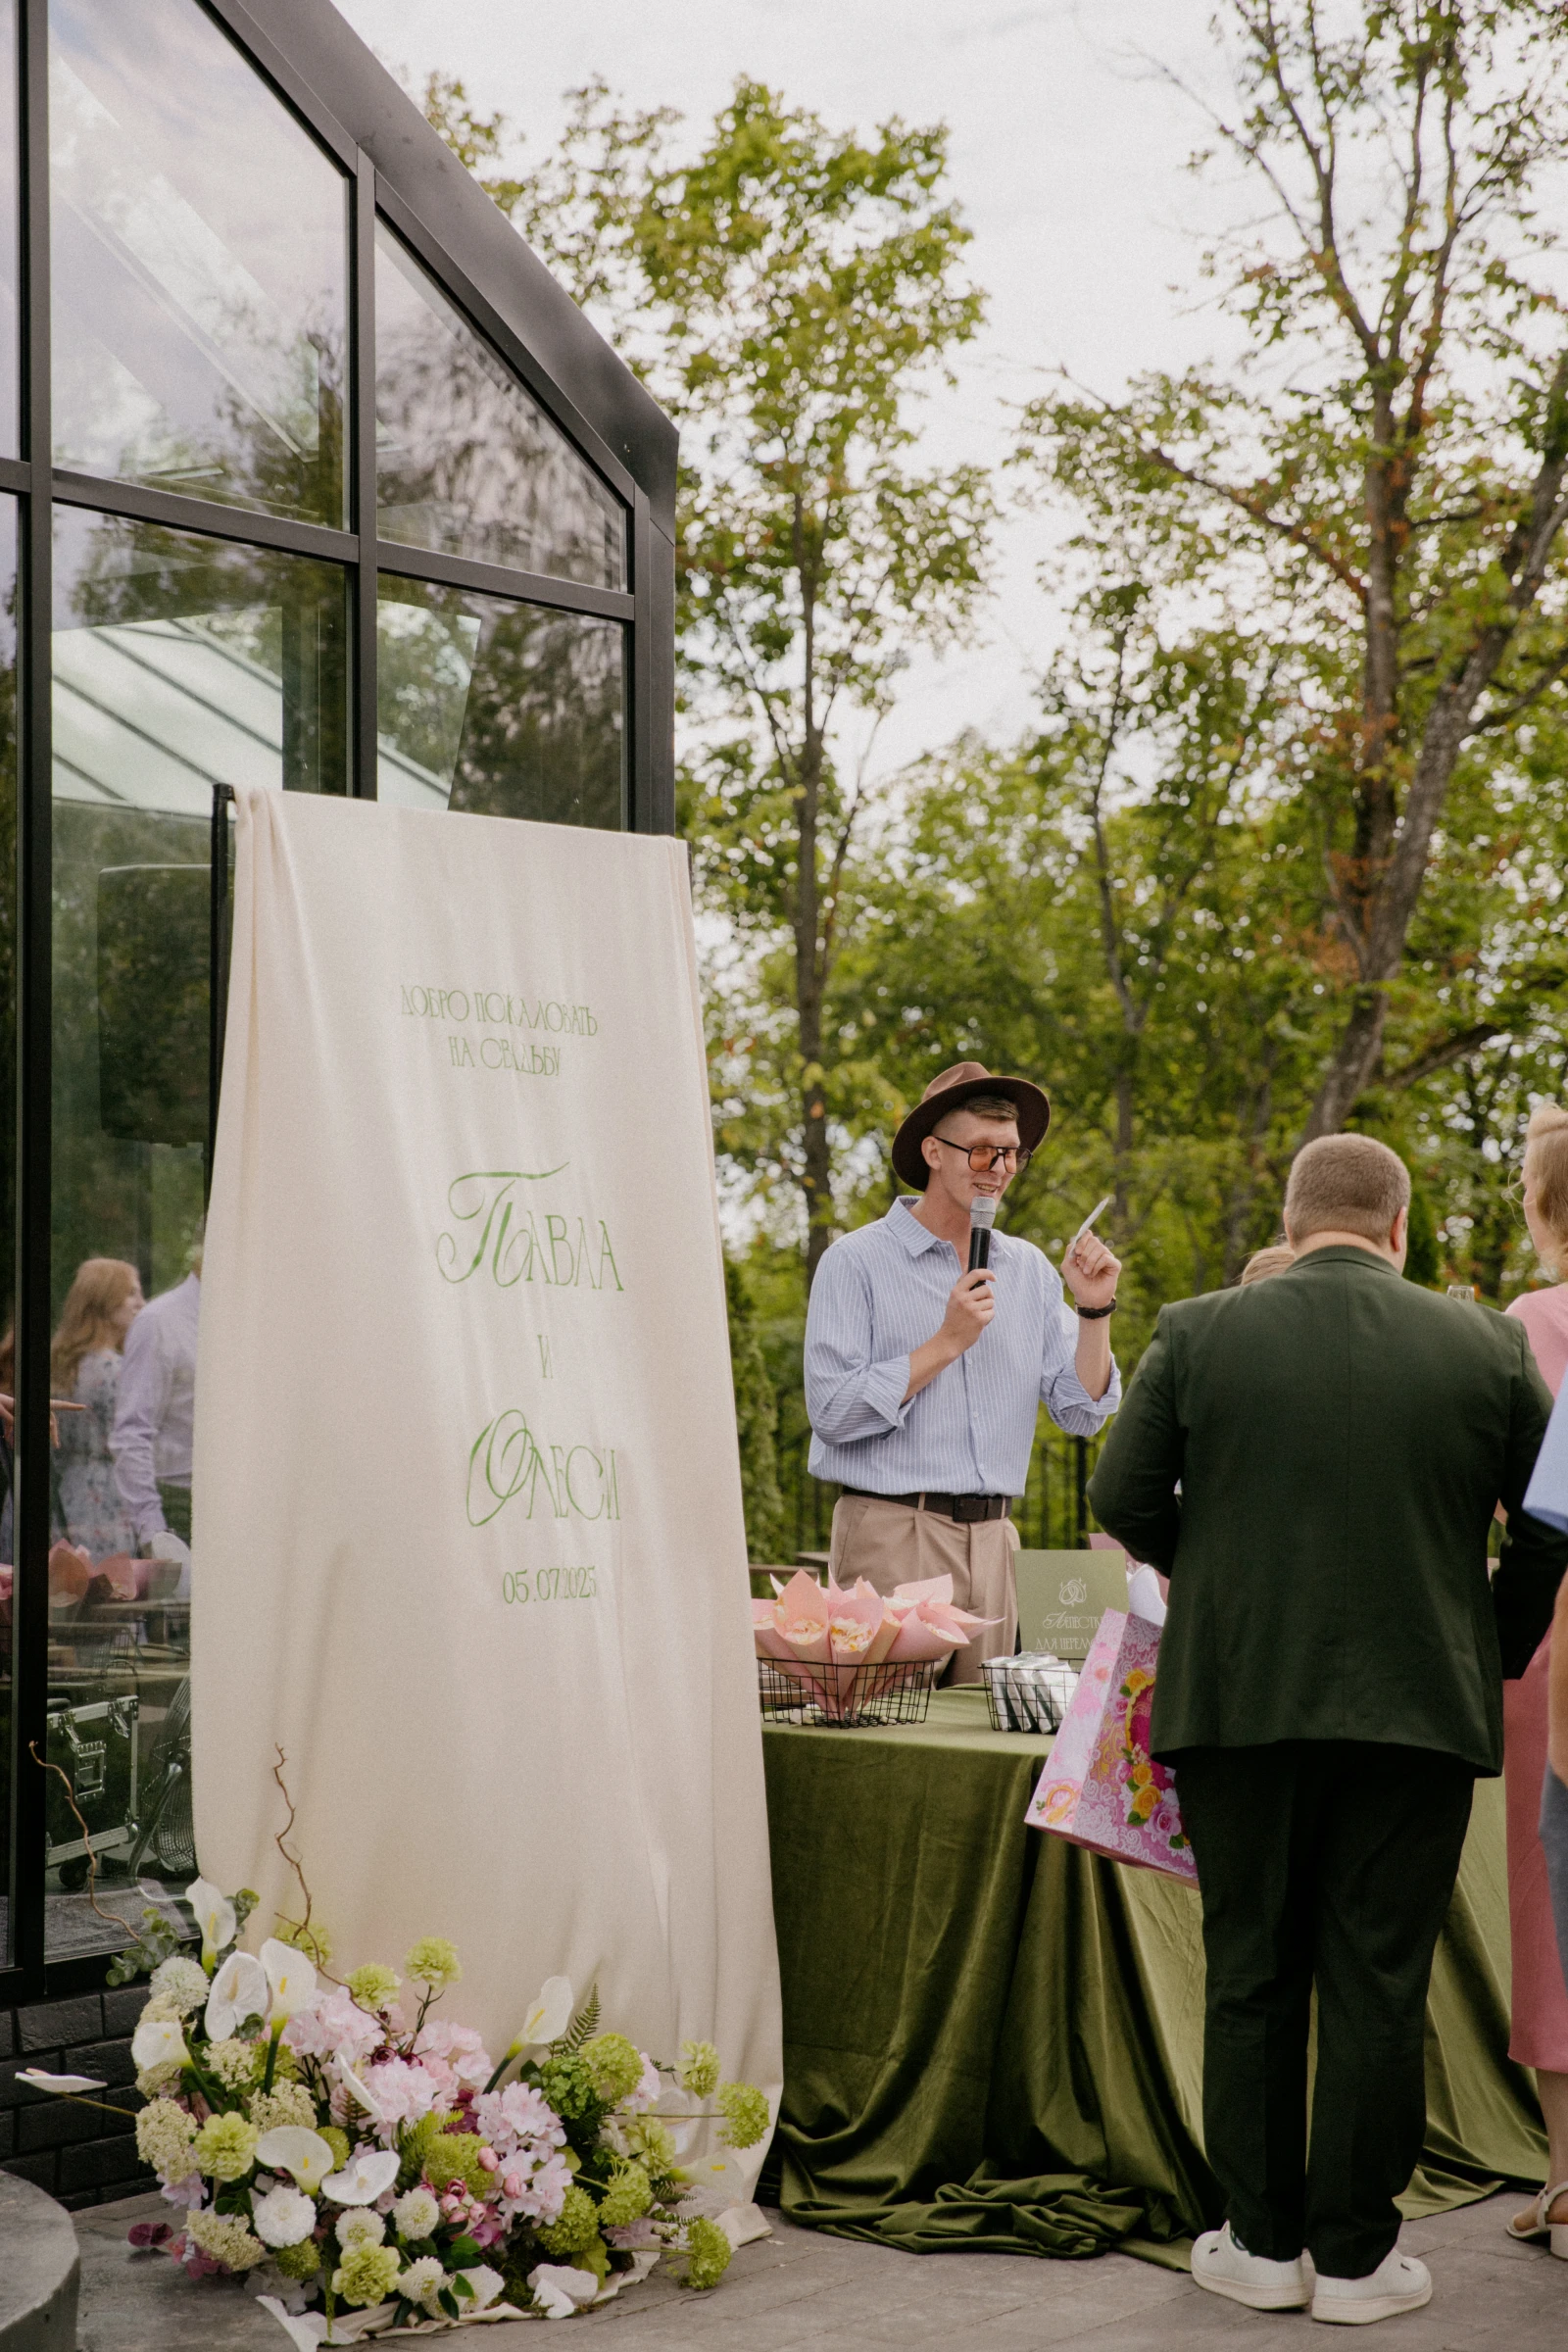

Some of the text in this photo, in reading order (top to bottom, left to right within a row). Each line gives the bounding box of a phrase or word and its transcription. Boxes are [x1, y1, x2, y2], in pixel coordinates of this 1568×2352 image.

[400, 985, 469, 1021] ДОБРО
[448, 1036, 475, 1067] НА
[537, 1334, 554, 1379] И
[502, 1565, 597, 1604] 05.07.2025
[1042, 1610, 1102, 1629] ЛЕПЕСТК
[1035, 1638, 1057, 1650] ДЛЯ
